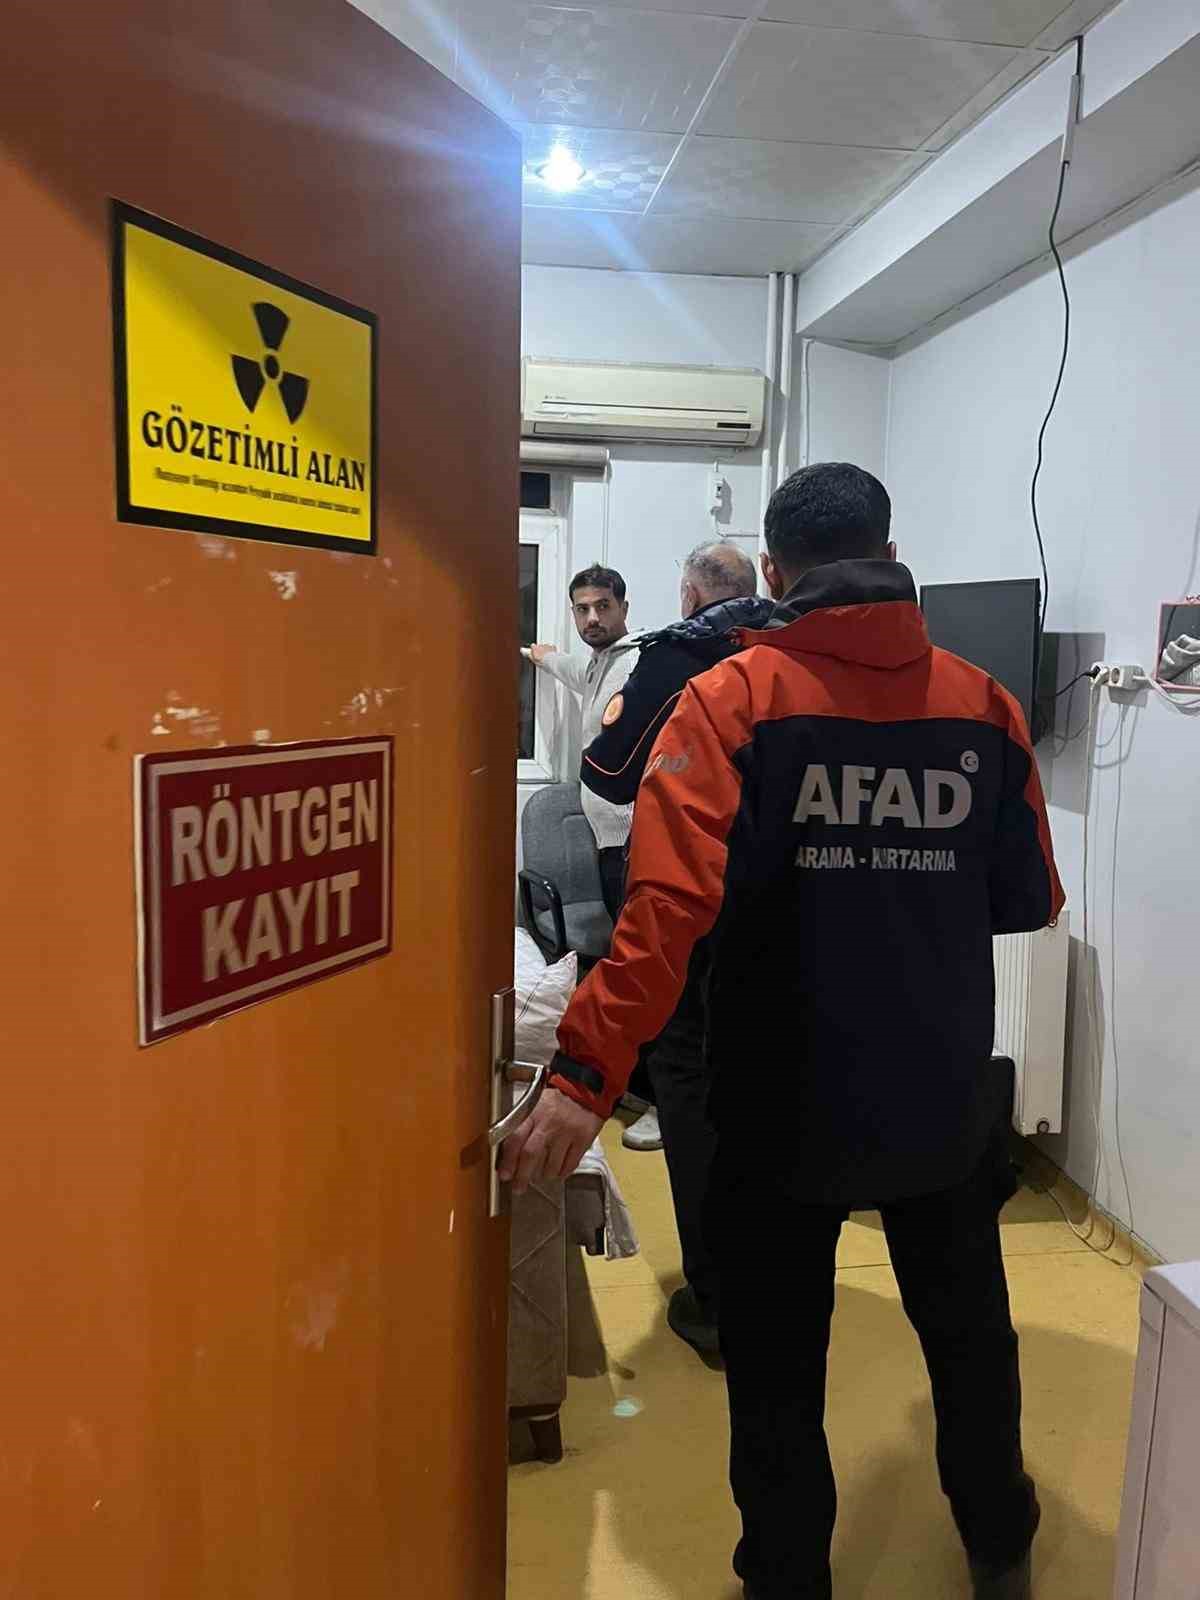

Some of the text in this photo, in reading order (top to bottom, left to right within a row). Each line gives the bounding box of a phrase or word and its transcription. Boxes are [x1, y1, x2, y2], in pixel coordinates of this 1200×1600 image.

[142, 403, 299, 478] GÖZETİMLİ
[306, 450, 366, 491] ALAN
[170, 778, 378, 887] RÖNTGEN
[792, 764, 972, 829] AFAD
[795, 846, 855, 869] ARAMA
[201, 869, 360, 983] KAYIT
